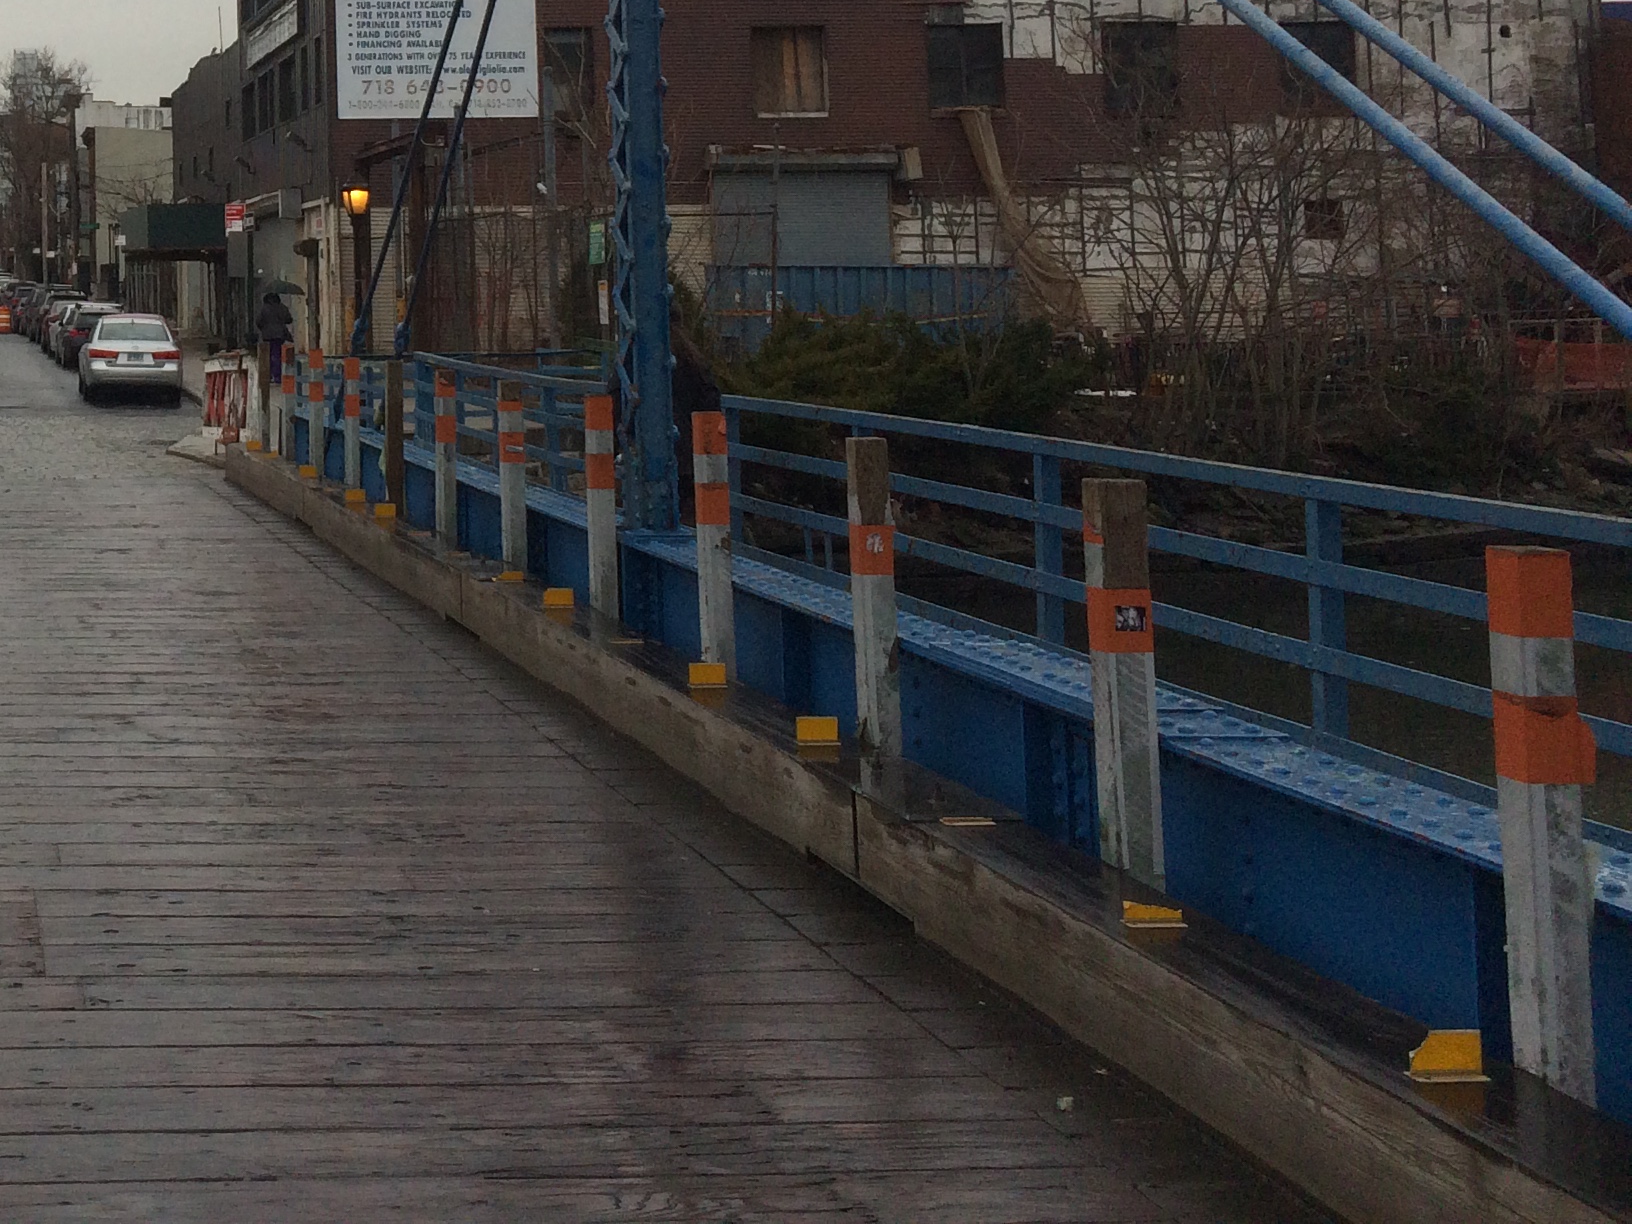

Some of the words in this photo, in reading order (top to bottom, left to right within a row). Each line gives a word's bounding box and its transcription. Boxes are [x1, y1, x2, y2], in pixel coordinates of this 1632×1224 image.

[356, 1, 411, 10] SUB-SURFACE
[356, 11, 373, 19] FIRE
[376, 11, 422, 19] HYDRANTS
[426, 10, 472, 18] RELOCTED
[356, 21, 400, 29] SPRINKLER
[406, 21, 443, 29] SYSTEMS
[356, 30, 380, 39] HAND
[384, 30, 422, 38] DIGGING
[357, 40, 403, 48] FINANCING
[407, 40, 447, 48] AVAILABL
[355, 53, 403, 61] GENERATIONS
[406, 53, 425, 61] WITH
[485, 51, 526, 60] EXPERIENCE
[351, 65, 372, 75] VISIT
[375, 65, 393, 74] OUR
[361, 79, 395, 95] 718
